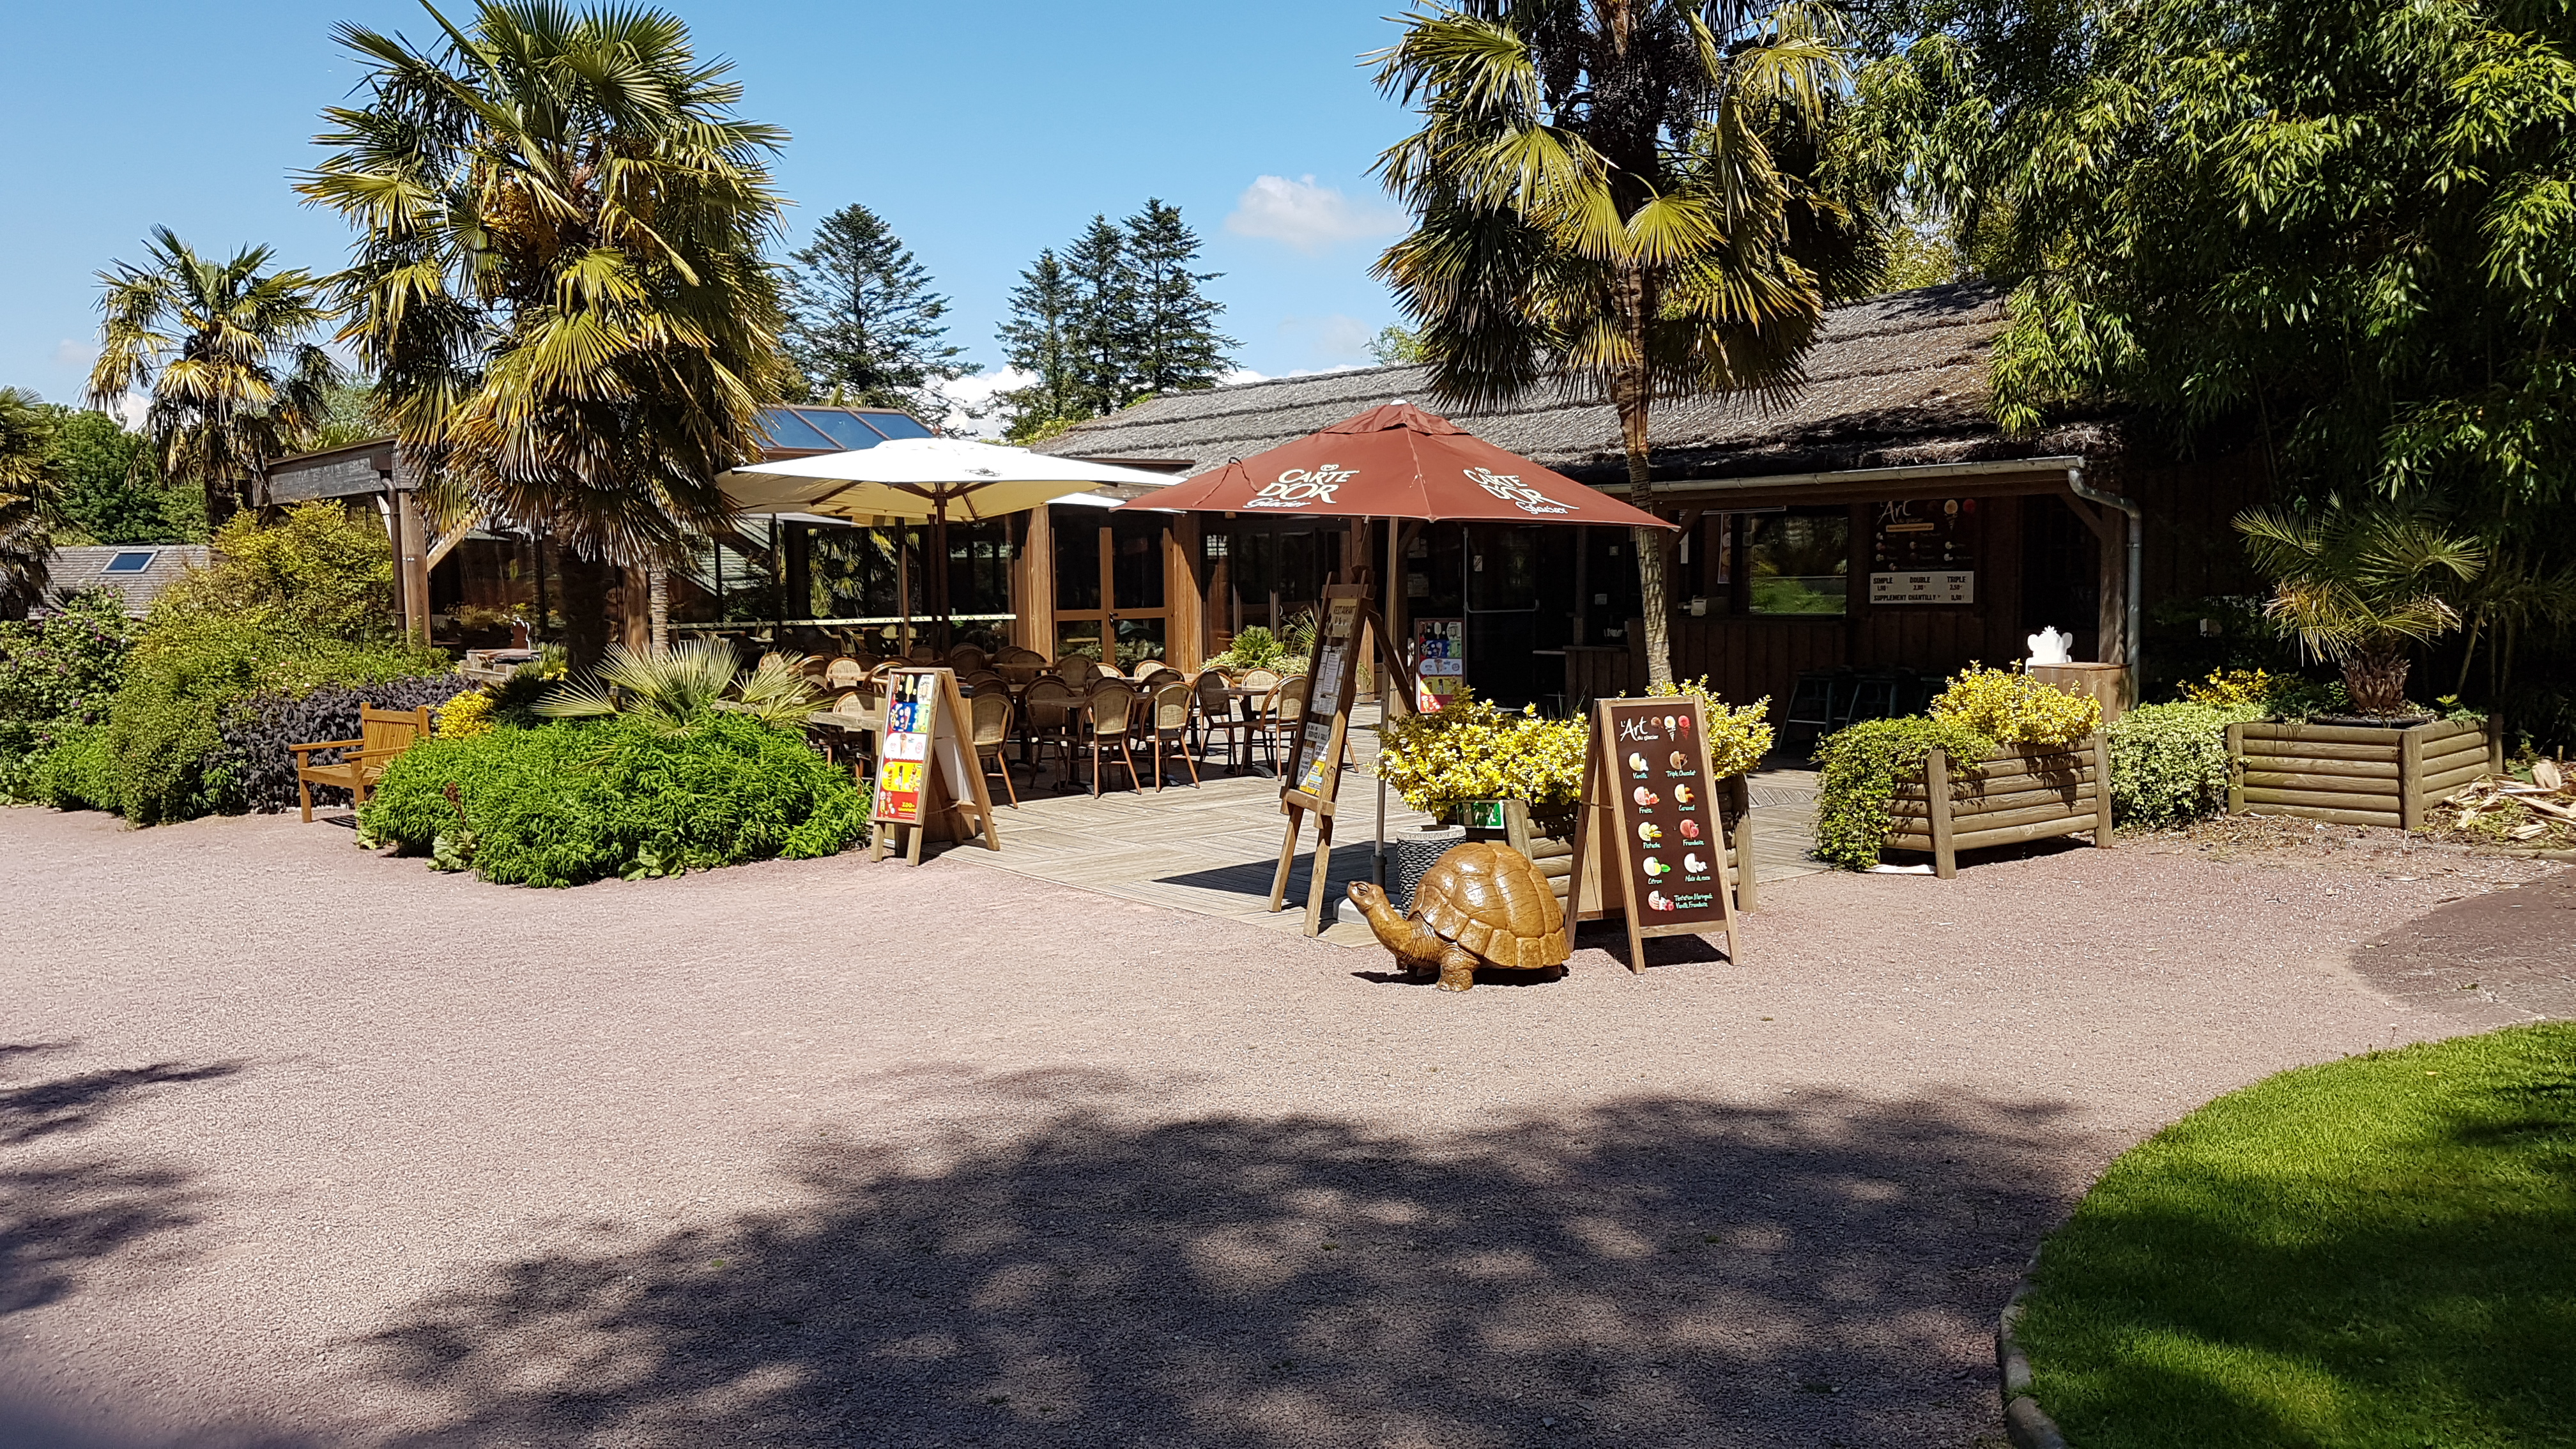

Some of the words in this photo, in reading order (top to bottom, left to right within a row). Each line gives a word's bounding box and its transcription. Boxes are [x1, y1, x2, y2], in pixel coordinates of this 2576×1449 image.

[1278, 468, 1360, 485] CARTE
[1462, 469, 1528, 489] CARTE
[1256, 482, 1339, 503] D'OR
[1479, 484, 1579, 505] D'OR
[1243, 497, 1311, 509] Glacier
[1665, 770, 1679, 778] Triple
